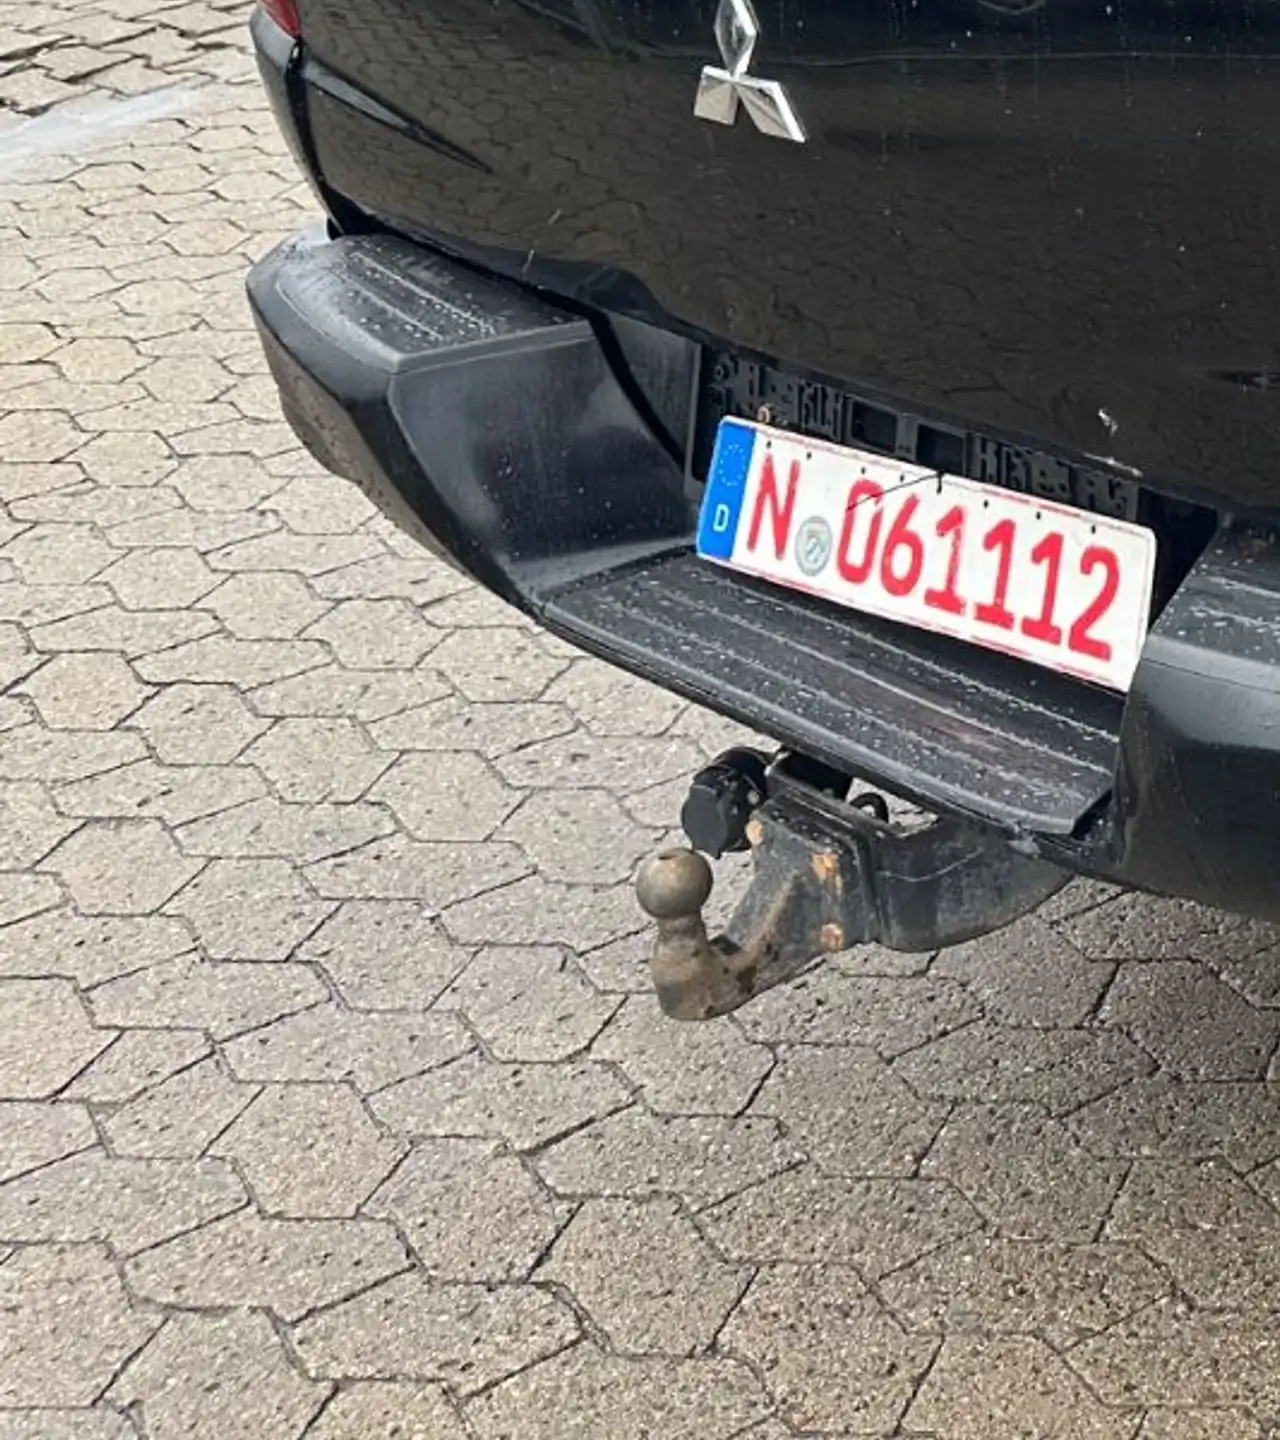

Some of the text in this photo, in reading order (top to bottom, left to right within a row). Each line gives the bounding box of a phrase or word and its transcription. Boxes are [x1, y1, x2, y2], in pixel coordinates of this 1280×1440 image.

[712, 503, 730, 533] D
[746, 453, 1121, 662] N 061112
